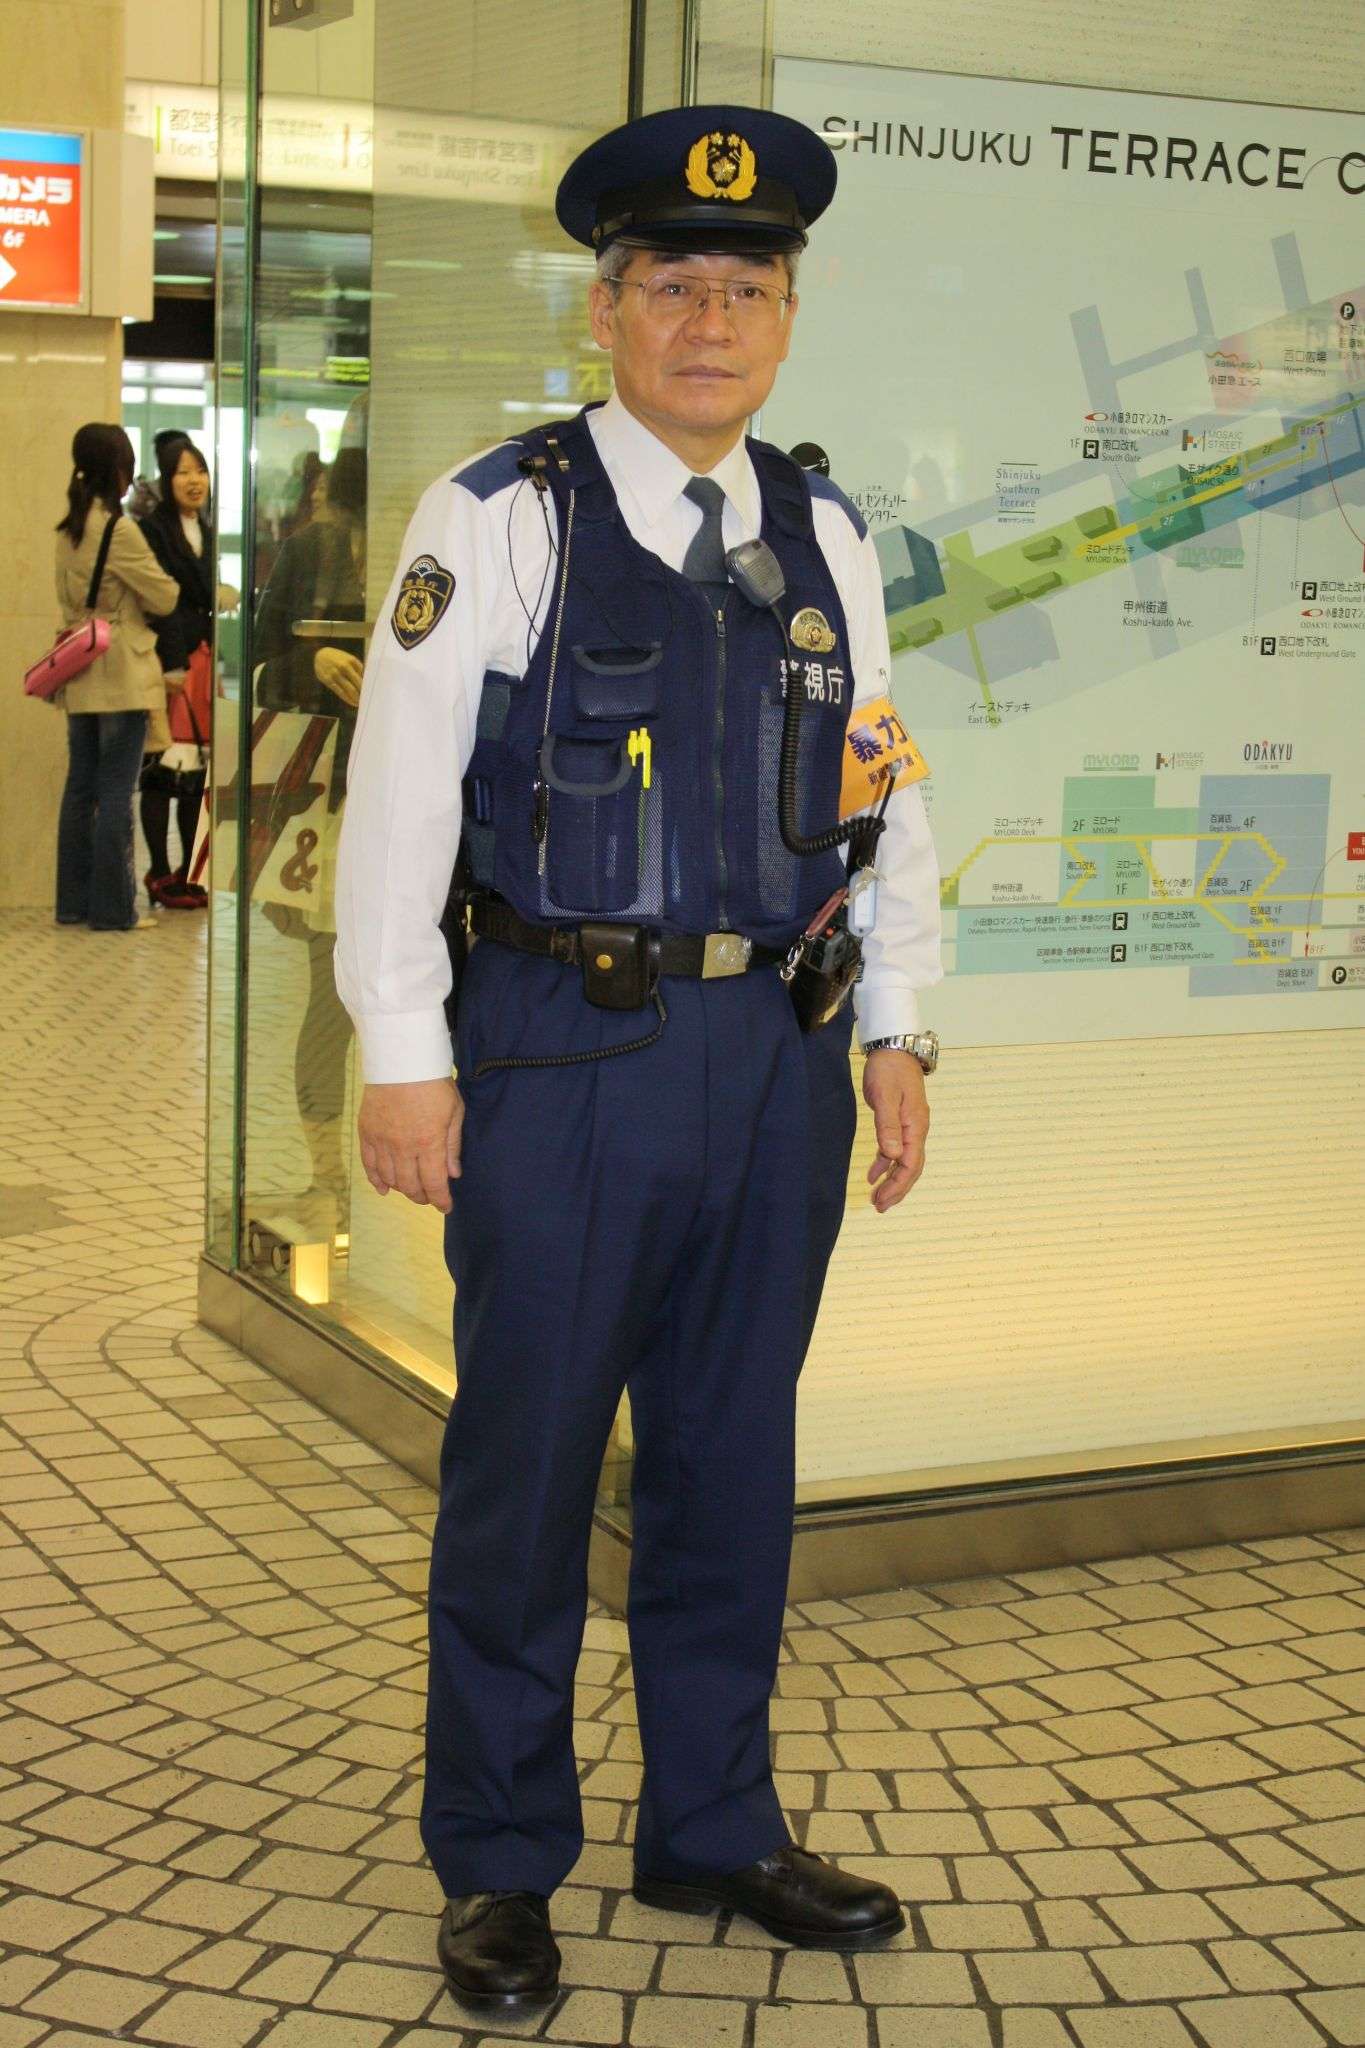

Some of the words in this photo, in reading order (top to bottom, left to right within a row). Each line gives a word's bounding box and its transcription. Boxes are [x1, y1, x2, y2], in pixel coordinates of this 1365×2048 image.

[822, 116, 1031, 166] SHINJUKU
[1051, 125, 1306, 190] TERRACE
[1123, 600, 1168, 614] 甲州街道
[968, 701, 1032, 713] イーストデッキ
[1244, 741, 1293, 761] ODAKYU
[1072, 819, 1085, 832] 2F
[1243, 816, 1256, 828] 4F
[1116, 884, 1128, 896] 1F
[1240, 880, 1252, 892] 2F
